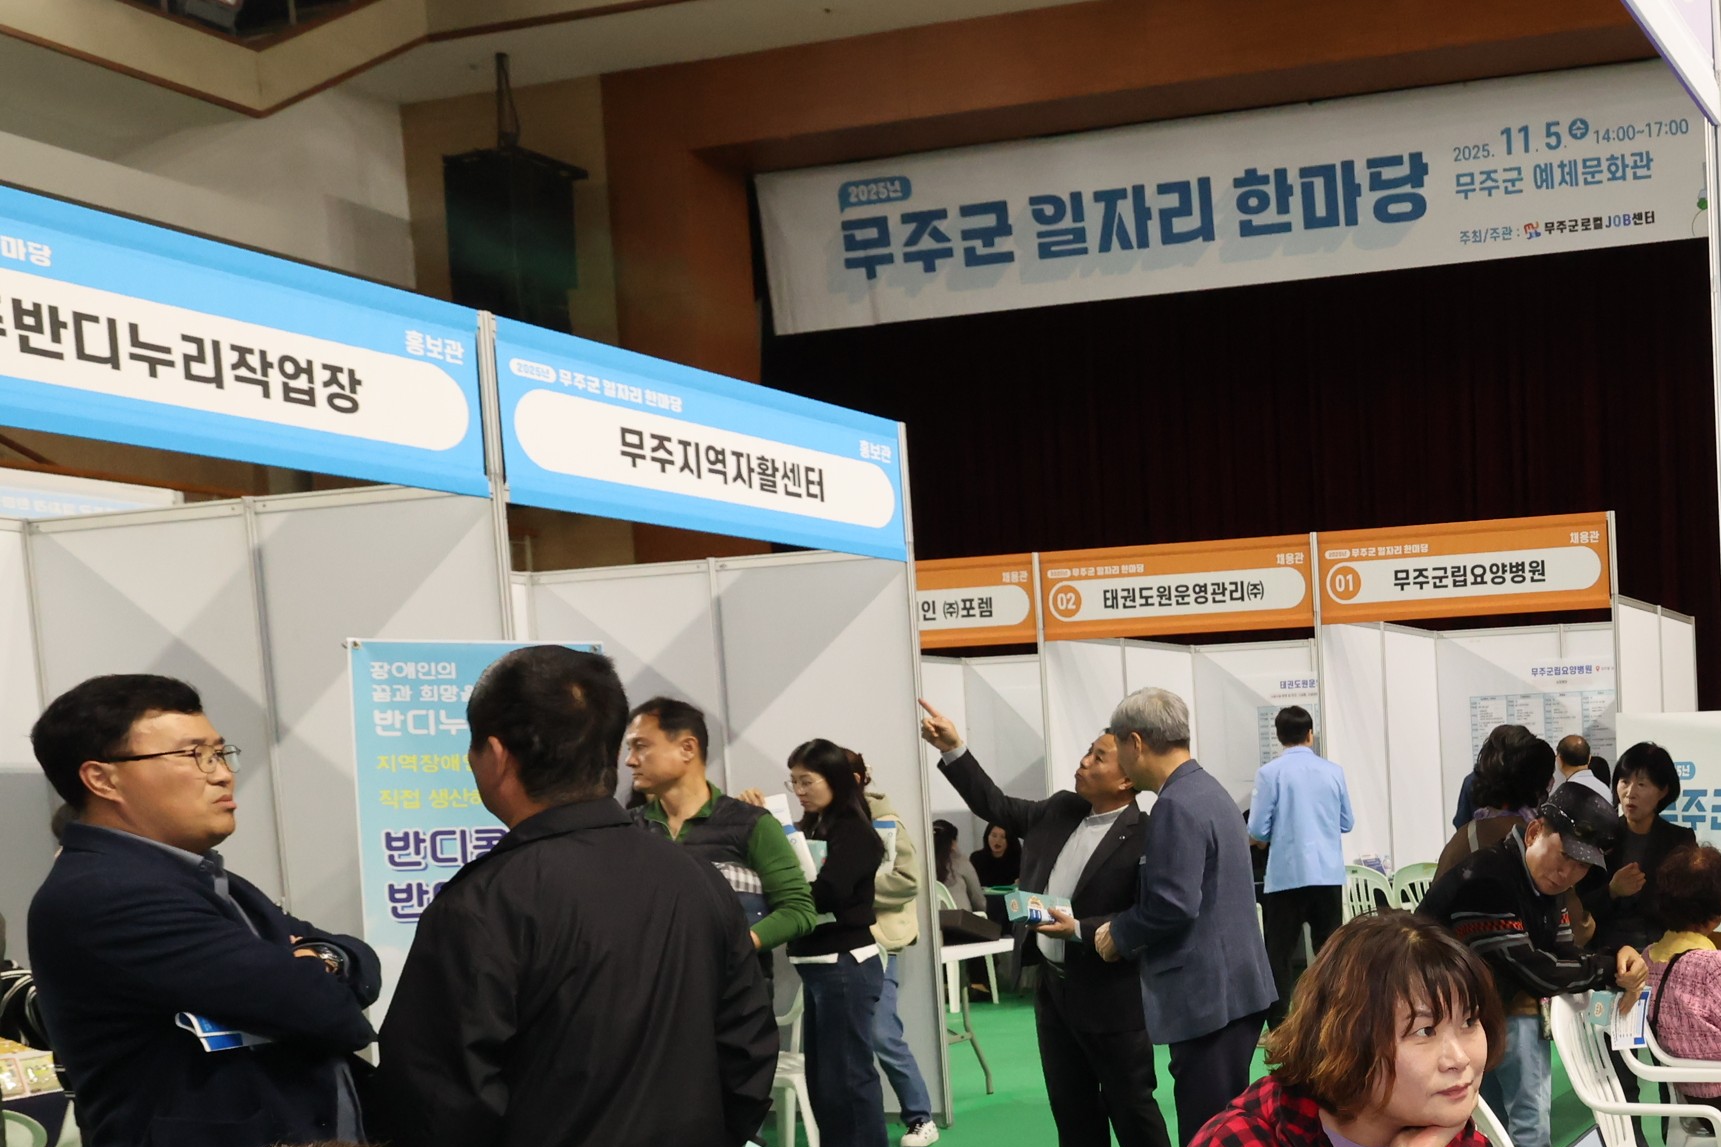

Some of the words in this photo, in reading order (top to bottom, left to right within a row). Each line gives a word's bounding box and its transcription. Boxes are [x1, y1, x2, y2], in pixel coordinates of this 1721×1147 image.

[1593, 117, 1690, 145] 14:00~17:00
[1455, 166, 1525, 200] 무주군
[1533, 150, 1655, 191] 예체문화관
[847, 178, 904, 203] 2025년
[841, 199, 1018, 281] 무주군
[1032, 176, 1217, 262] 일자리
[1232, 151, 1431, 237] 한마당
[1459, 225, 1514, 245] 주최/주관
[404, 328, 466, 366] 홍보관
[558, 368, 602, 396] 무주군
[602, 379, 643, 405] 일자리
[643, 389, 684, 413] 한마당
[858, 438, 892, 465] 홍보관
[619, 425, 827, 504] 무주지역자활센터
[1569, 529, 1600, 545] 채용관
[1276, 551, 1305, 566] 채용관
[1001, 570, 1028, 584] 채용관
[1335, 573, 1354, 593] 01
[1393, 559, 1547, 592] 무주군립요양병원
[917, 599, 937, 622] 인
[1057, 592, 1077, 611] 02
[370, 661, 457, 680] 장애인의
[1531, 664, 1593, 677] 무주군립요양병원
[371, 684, 412, 702] 꿈과
[1279, 678, 1318, 690] 태권도원운
[373, 708, 471, 736] 반디누
[379, 788, 422, 810] 직접
[387, 882, 445, 919] 반
